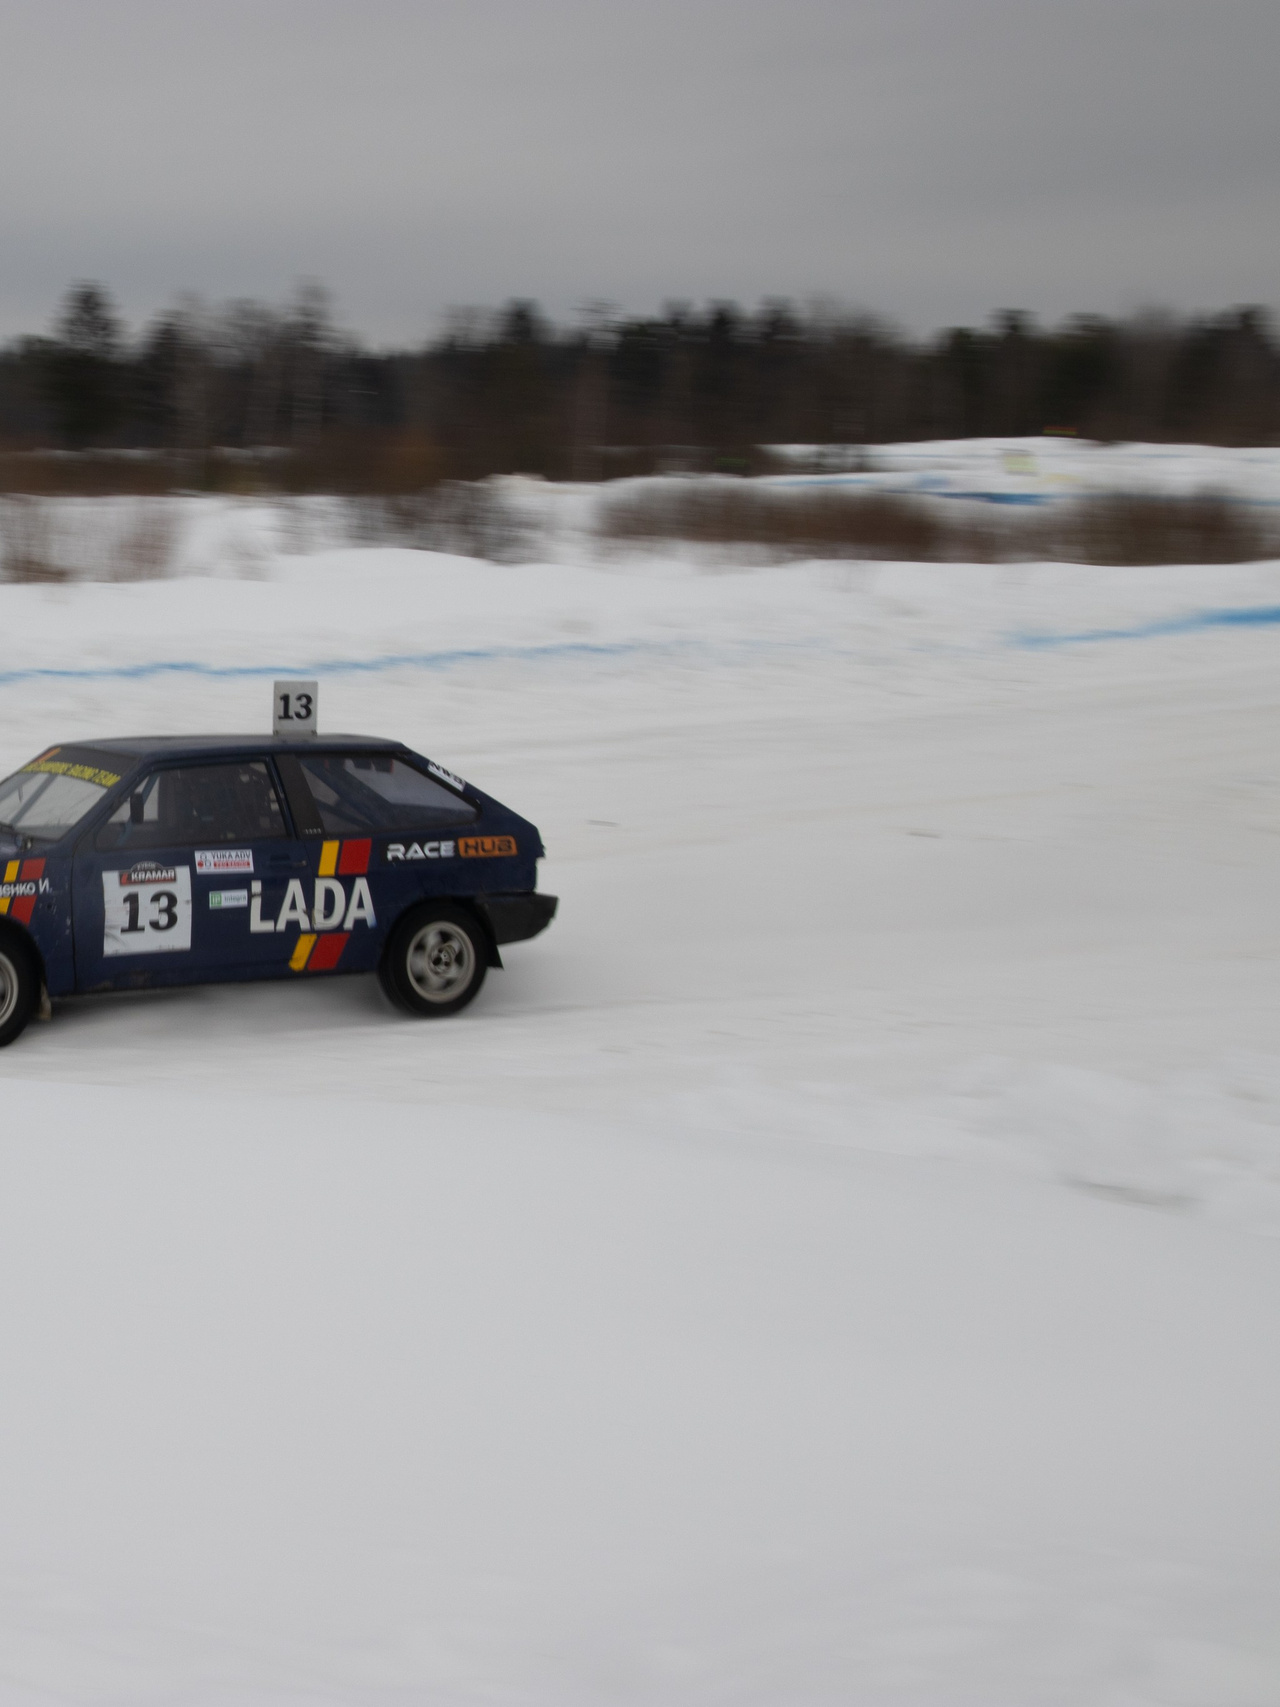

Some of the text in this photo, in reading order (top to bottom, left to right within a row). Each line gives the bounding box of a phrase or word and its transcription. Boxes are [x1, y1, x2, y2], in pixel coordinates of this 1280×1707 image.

[278, 693, 312, 720] 13
[386, 837, 514, 861] RACE HUB
[131, 869, 175, 882] KRAMAR
[120, 889, 179, 935] 13
[249, 876, 378, 934] LADA
